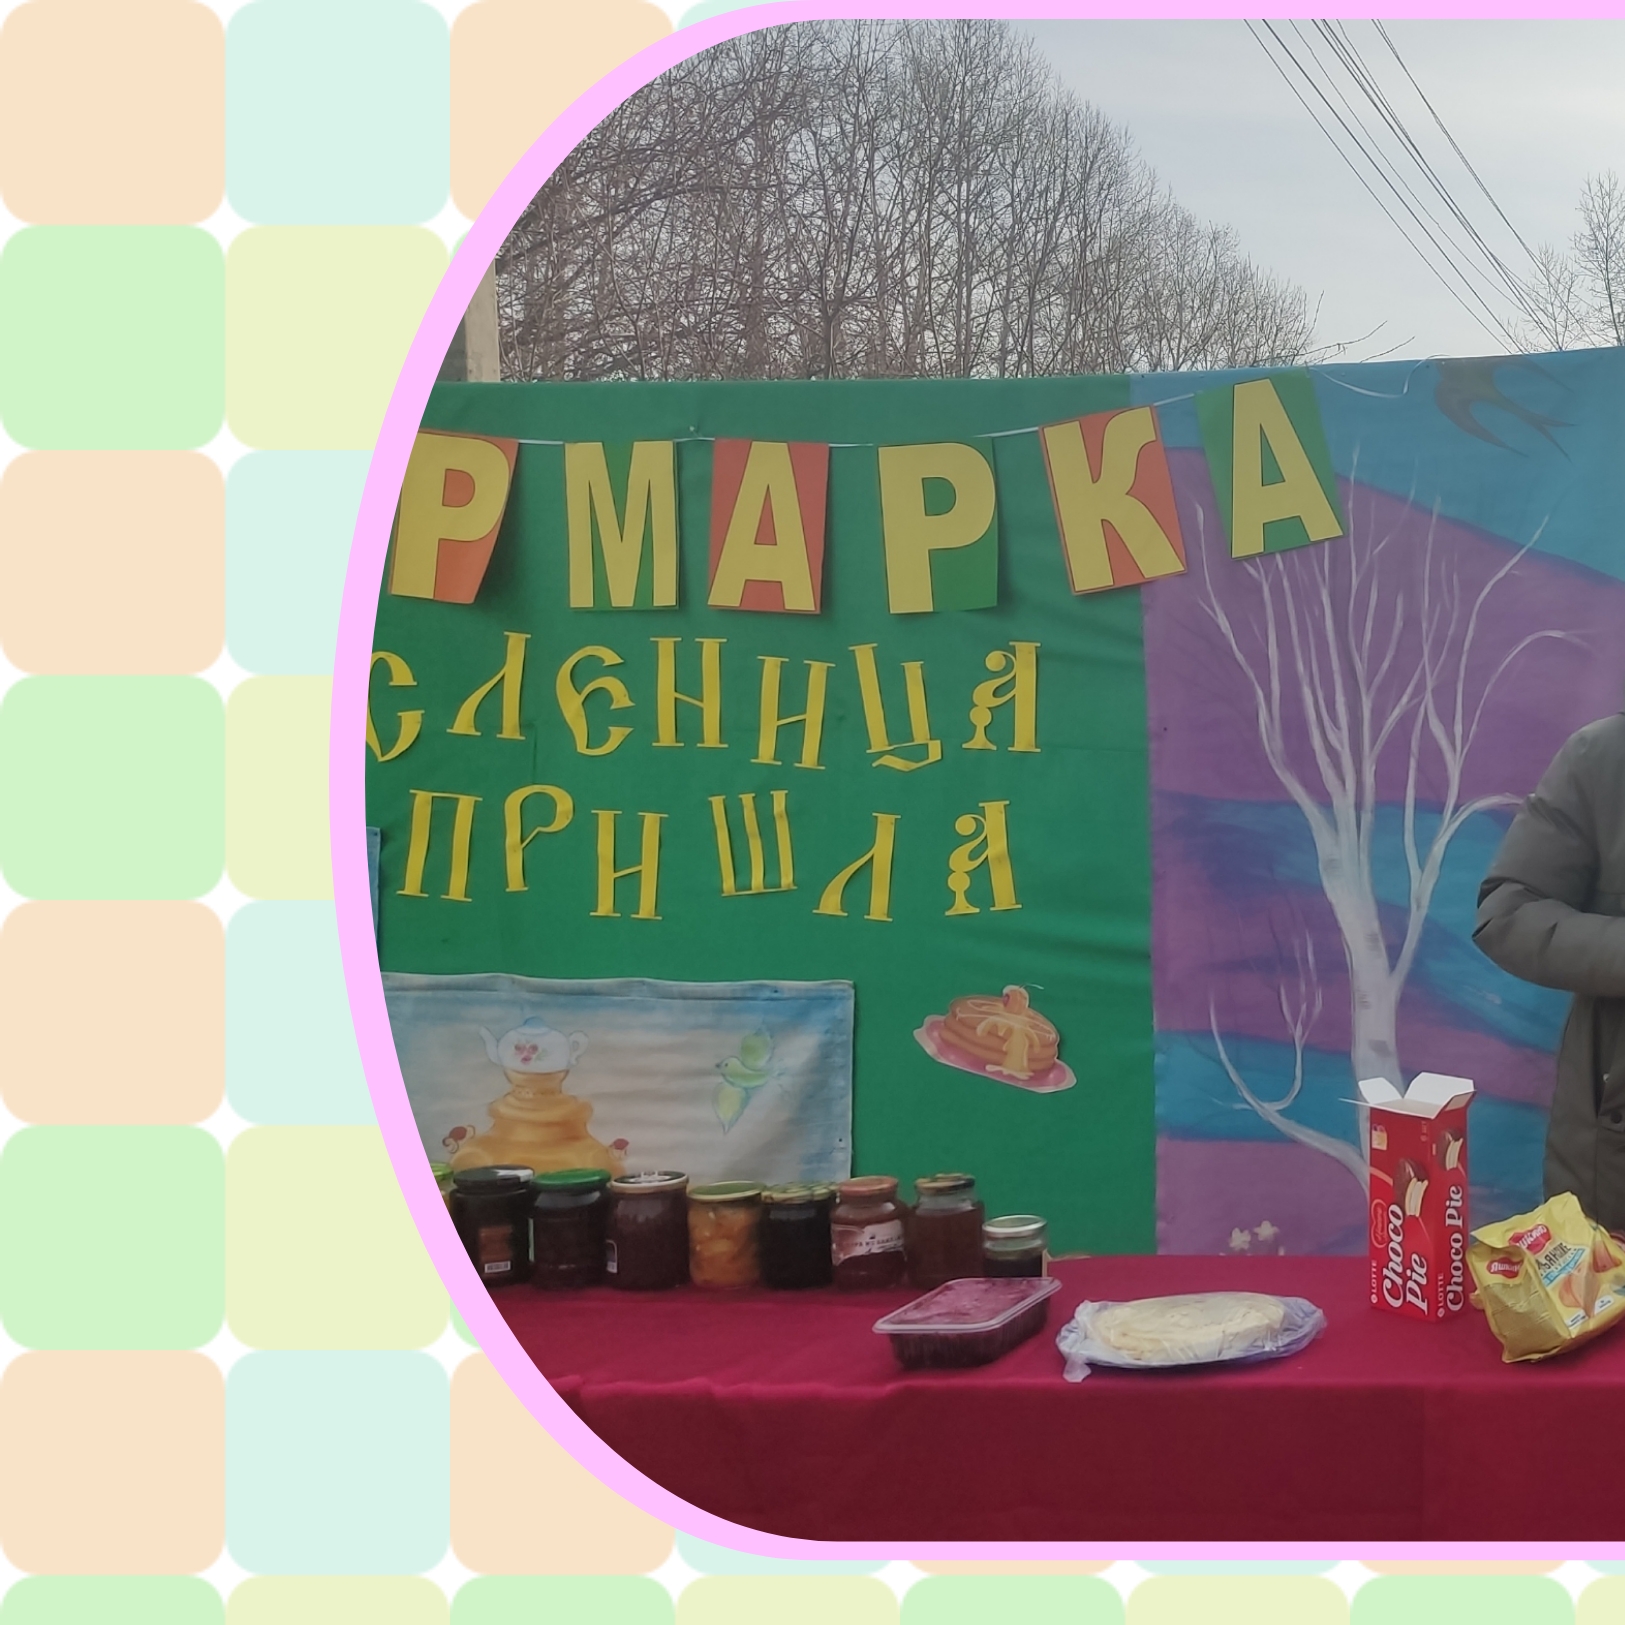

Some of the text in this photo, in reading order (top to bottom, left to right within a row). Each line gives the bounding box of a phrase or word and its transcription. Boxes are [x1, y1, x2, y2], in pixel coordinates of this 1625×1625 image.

[389, 378, 1343, 614] РМАРКА
[1383, 1204, 1405, 1308] Choco
[1406, 1253, 1428, 1316] Pie
[1446, 1185, 1464, 1312] Choco Pie
